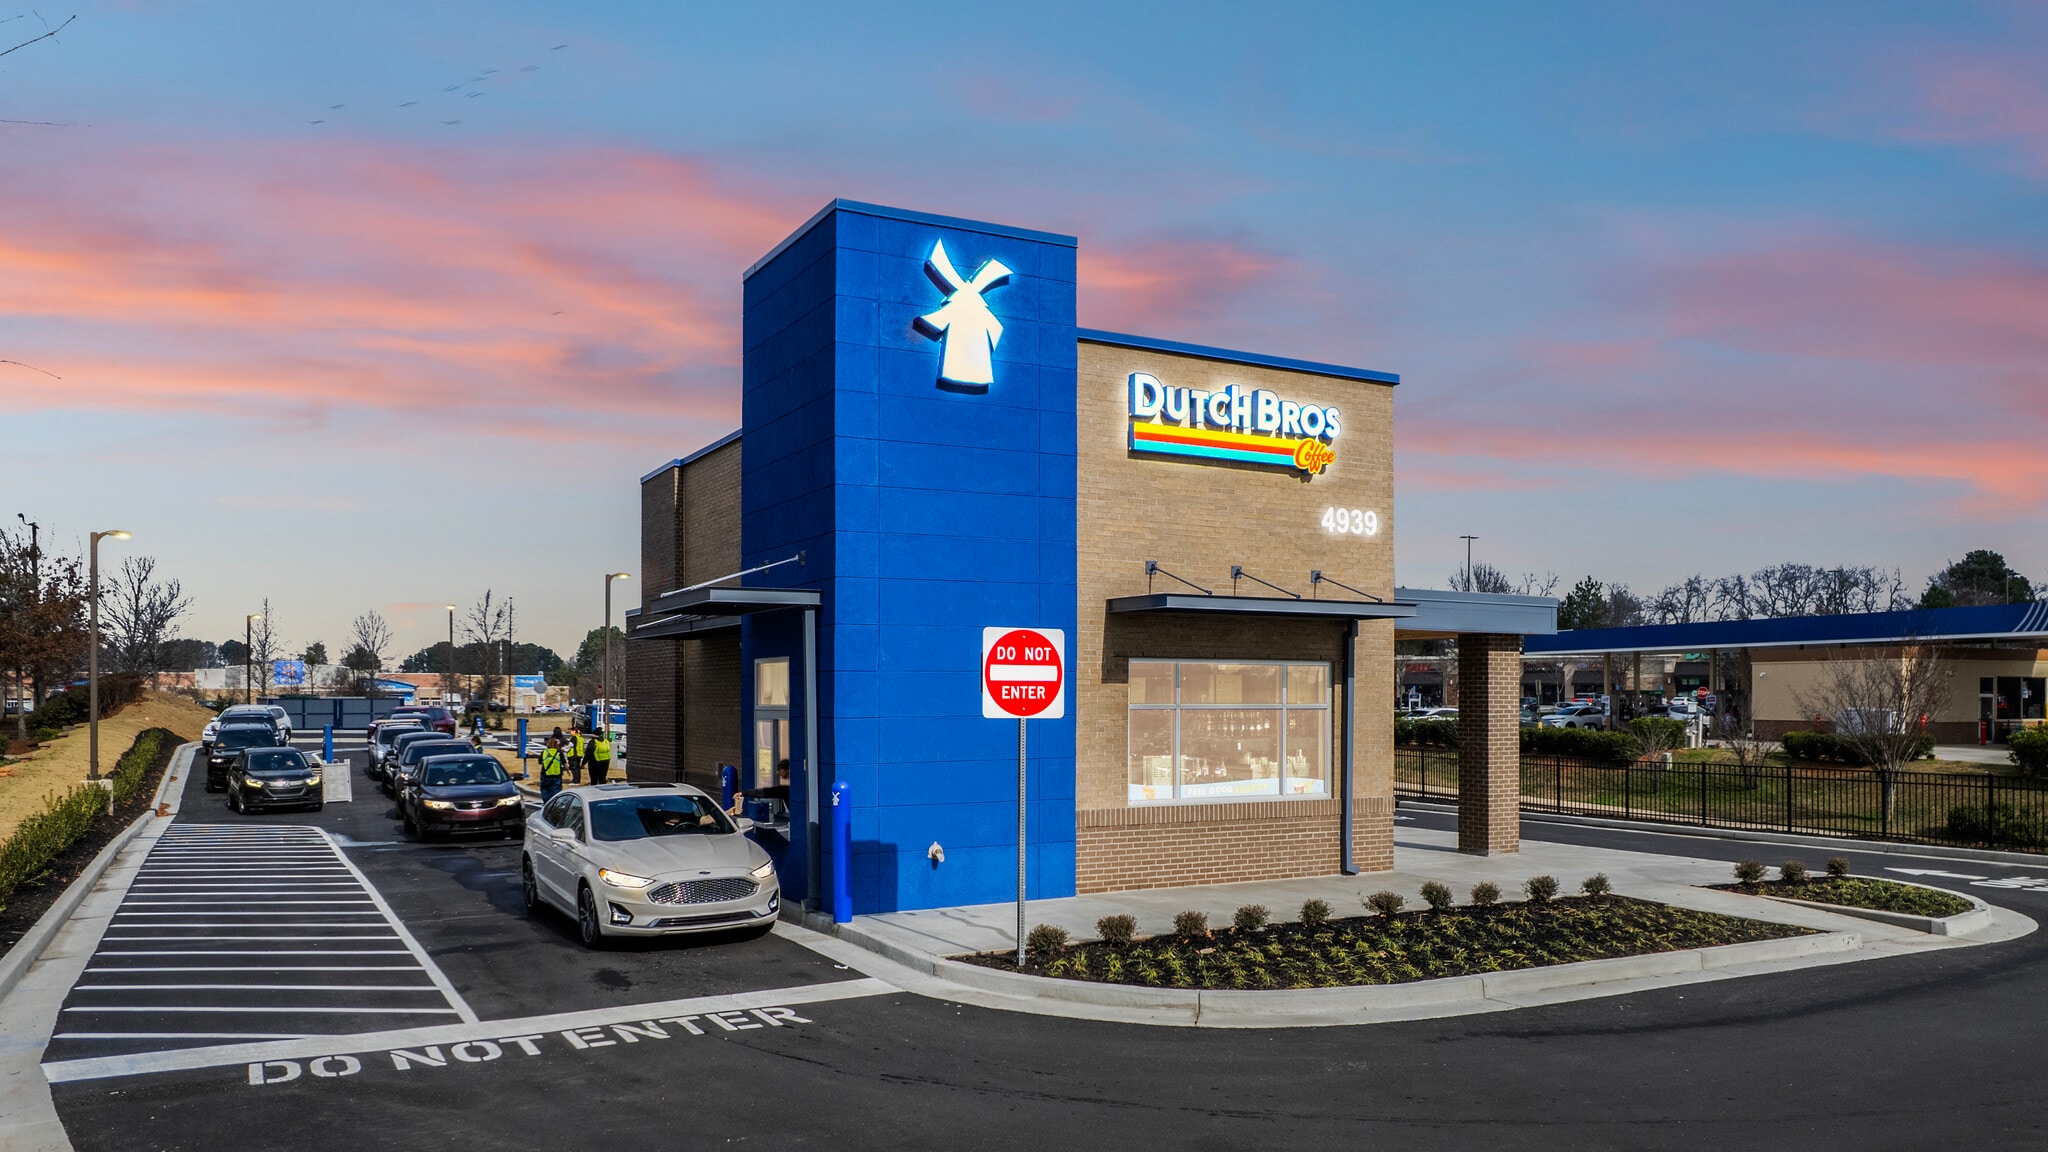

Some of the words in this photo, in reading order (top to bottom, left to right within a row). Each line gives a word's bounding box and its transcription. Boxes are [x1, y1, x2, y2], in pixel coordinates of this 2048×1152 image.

[1129, 372, 1251, 428] DUTCH
[1252, 388, 1342, 440] BROS
[1294, 438, 1336, 474] Coffee
[1321, 507, 1378, 536] 4939
[996, 646, 1016, 660] DO
[1024, 647, 1052, 661] NOT
[1001, 685, 1046, 700] ENTER
[1188, 788, 1207, 796] FEEL
[1209, 786, 1233, 794] GOOD
[247, 1055, 362, 1085] DO
[389, 1034, 543, 1071] NOT
[562, 1006, 813, 1049] ENTER
